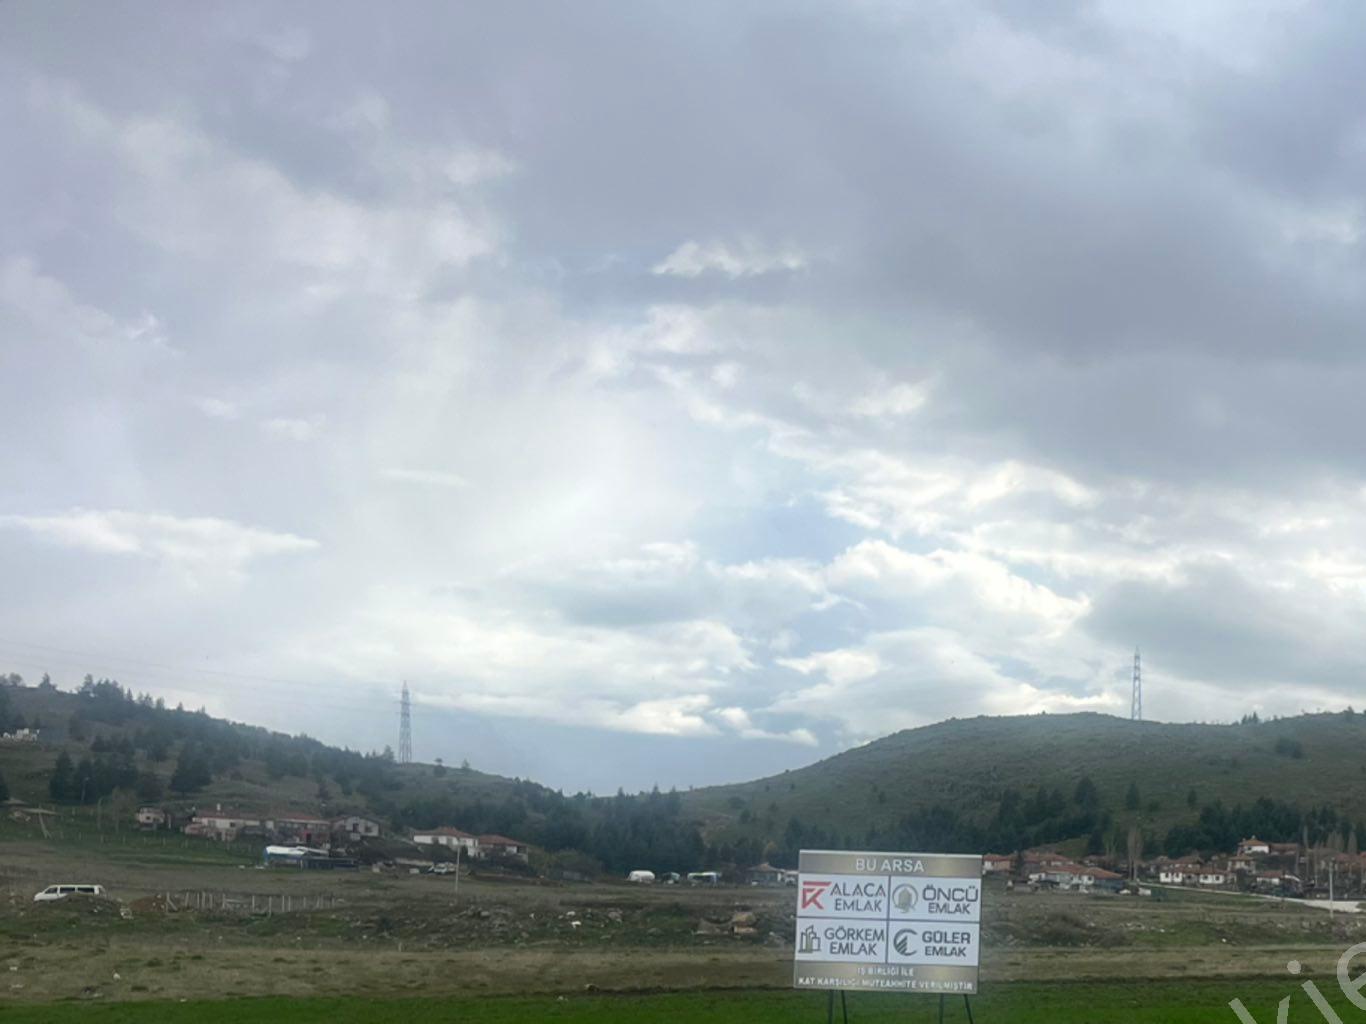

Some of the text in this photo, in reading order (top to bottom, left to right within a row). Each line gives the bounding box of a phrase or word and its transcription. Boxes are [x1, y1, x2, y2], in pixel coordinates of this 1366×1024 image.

[856, 859, 924, 872] BU ARSA
[830, 882, 886, 897] ALACA
[922, 885, 979, 902] ÖNCÜ
[834, 898, 882, 912] EMLAK
[928, 902, 970, 914] EMLAK
[824, 925, 885, 942] GÖRKEM
[922, 930, 971, 944] GÜLER
[829, 942, 878, 956] EMLAK
[924, 946, 967, 957] EMLAK
